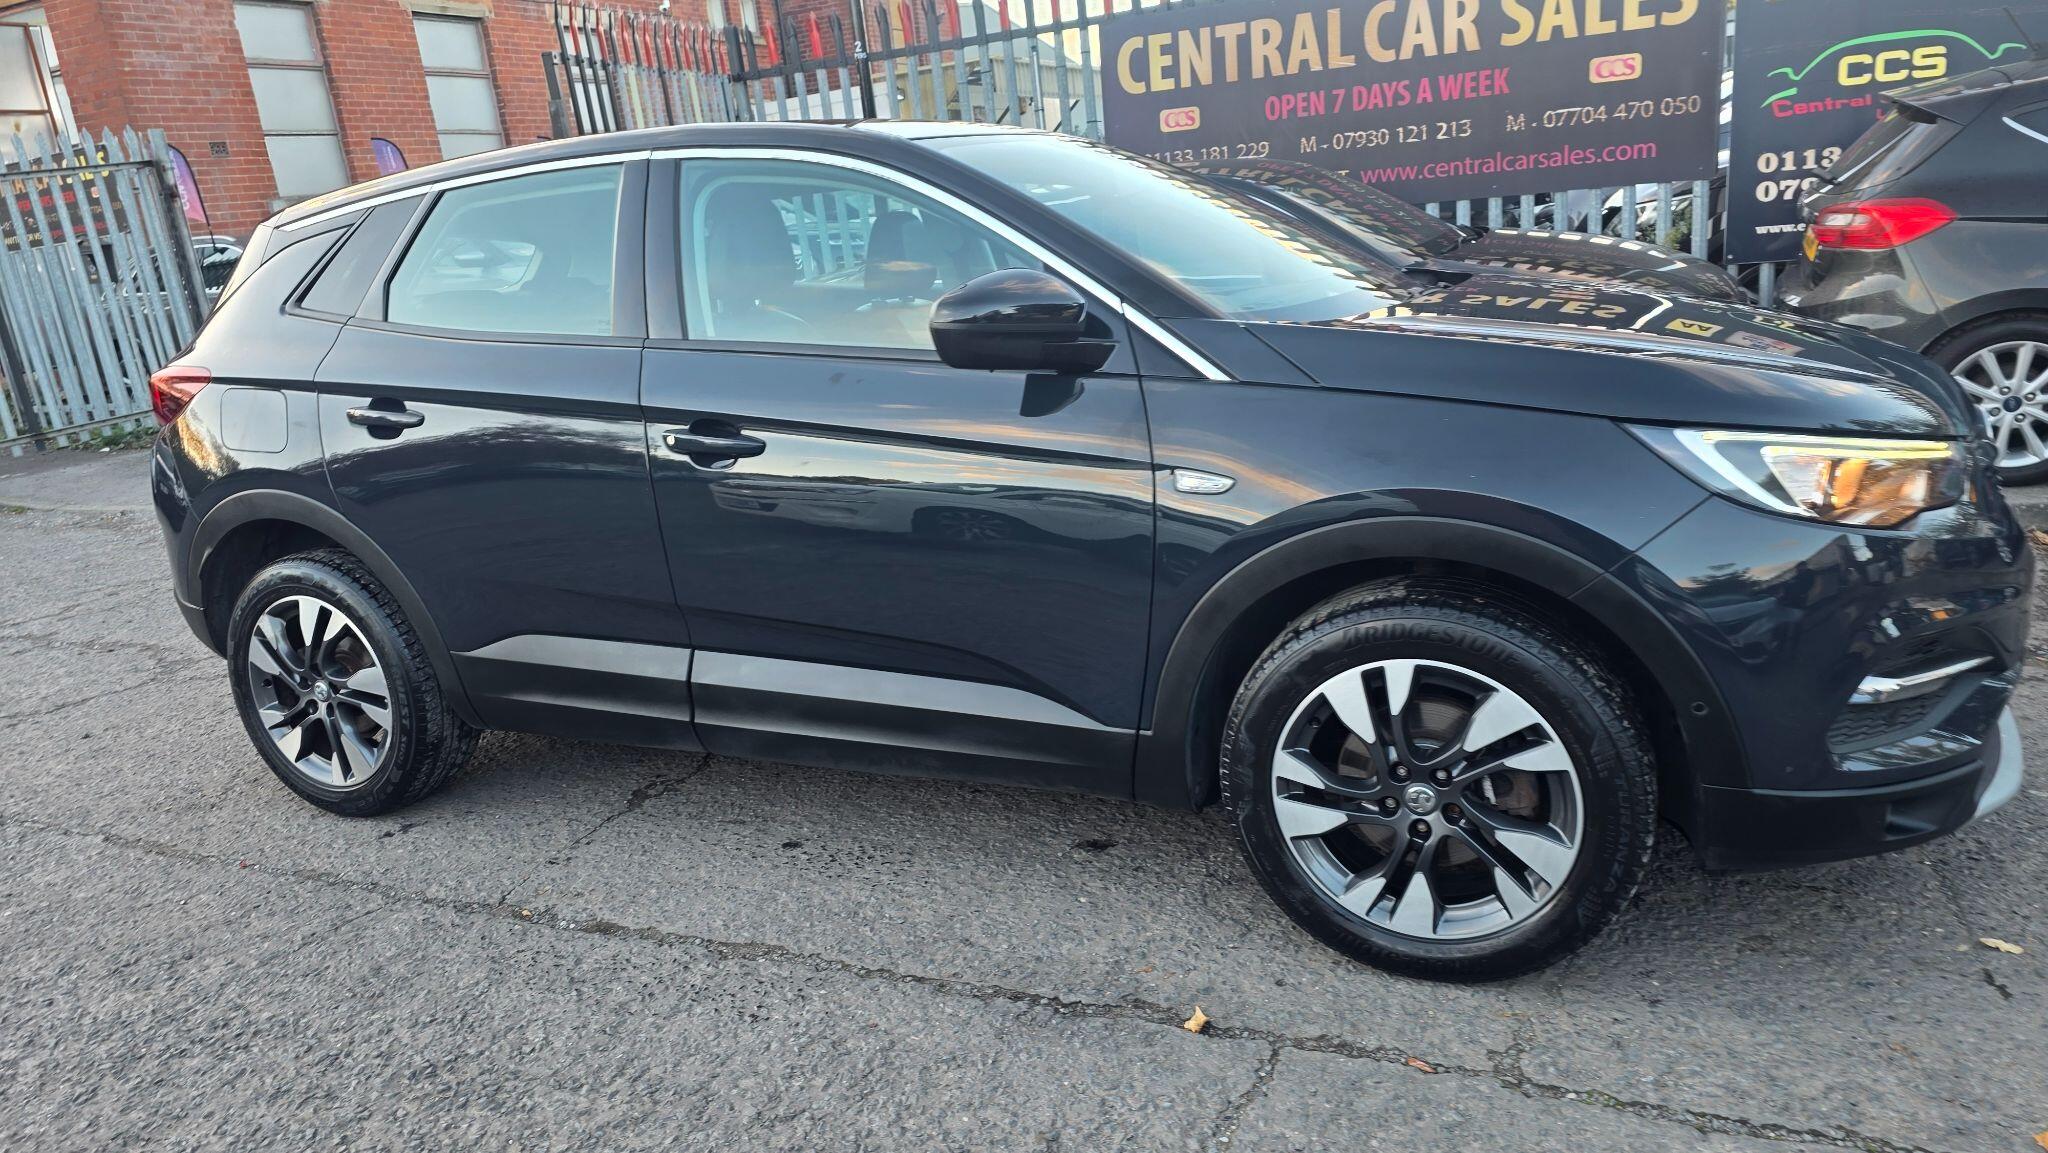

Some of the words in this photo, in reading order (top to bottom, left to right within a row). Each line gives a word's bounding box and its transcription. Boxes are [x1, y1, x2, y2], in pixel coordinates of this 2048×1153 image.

[854, 41, 862, 52] 2
[1117, 8, 1356, 94] CENTRAL
[1364, 0, 1480, 63] CAR
[1595, 57, 1636, 79] CCS
[1838, 46, 1947, 86] CCS
[1265, 90, 1325, 121] OPEN
[1332, 88, 1346, 114] 7
[1353, 79, 1410, 112] DAYS
[1416, 77, 1433, 104] A
[1438, 67, 1510, 101] WEEK
[1772, 93, 1872, 118] Central
[1163, 109, 1196, 128] CCS
[1505, 113, 1526, 131] M
[1542, 105, 1608, 128] 07704
[1612, 100, 1654, 120] 470
[1661, 95, 1701, 116] 050
[1200, 146, 1228, 160] 181
[1236, 141, 1269, 159] 229
[1300, 136, 1317, 153] M
[1332, 128, 1389, 150] 07930
[1396, 124, 1427, 143] 121
[1435, 119, 1472, 140] 213
[1361, 142, 1657, 183] www.centralcarsales.com
[1757, 147, 1842, 174] 0113
[1342, 622, 1521, 666] BRIDGESTONE
